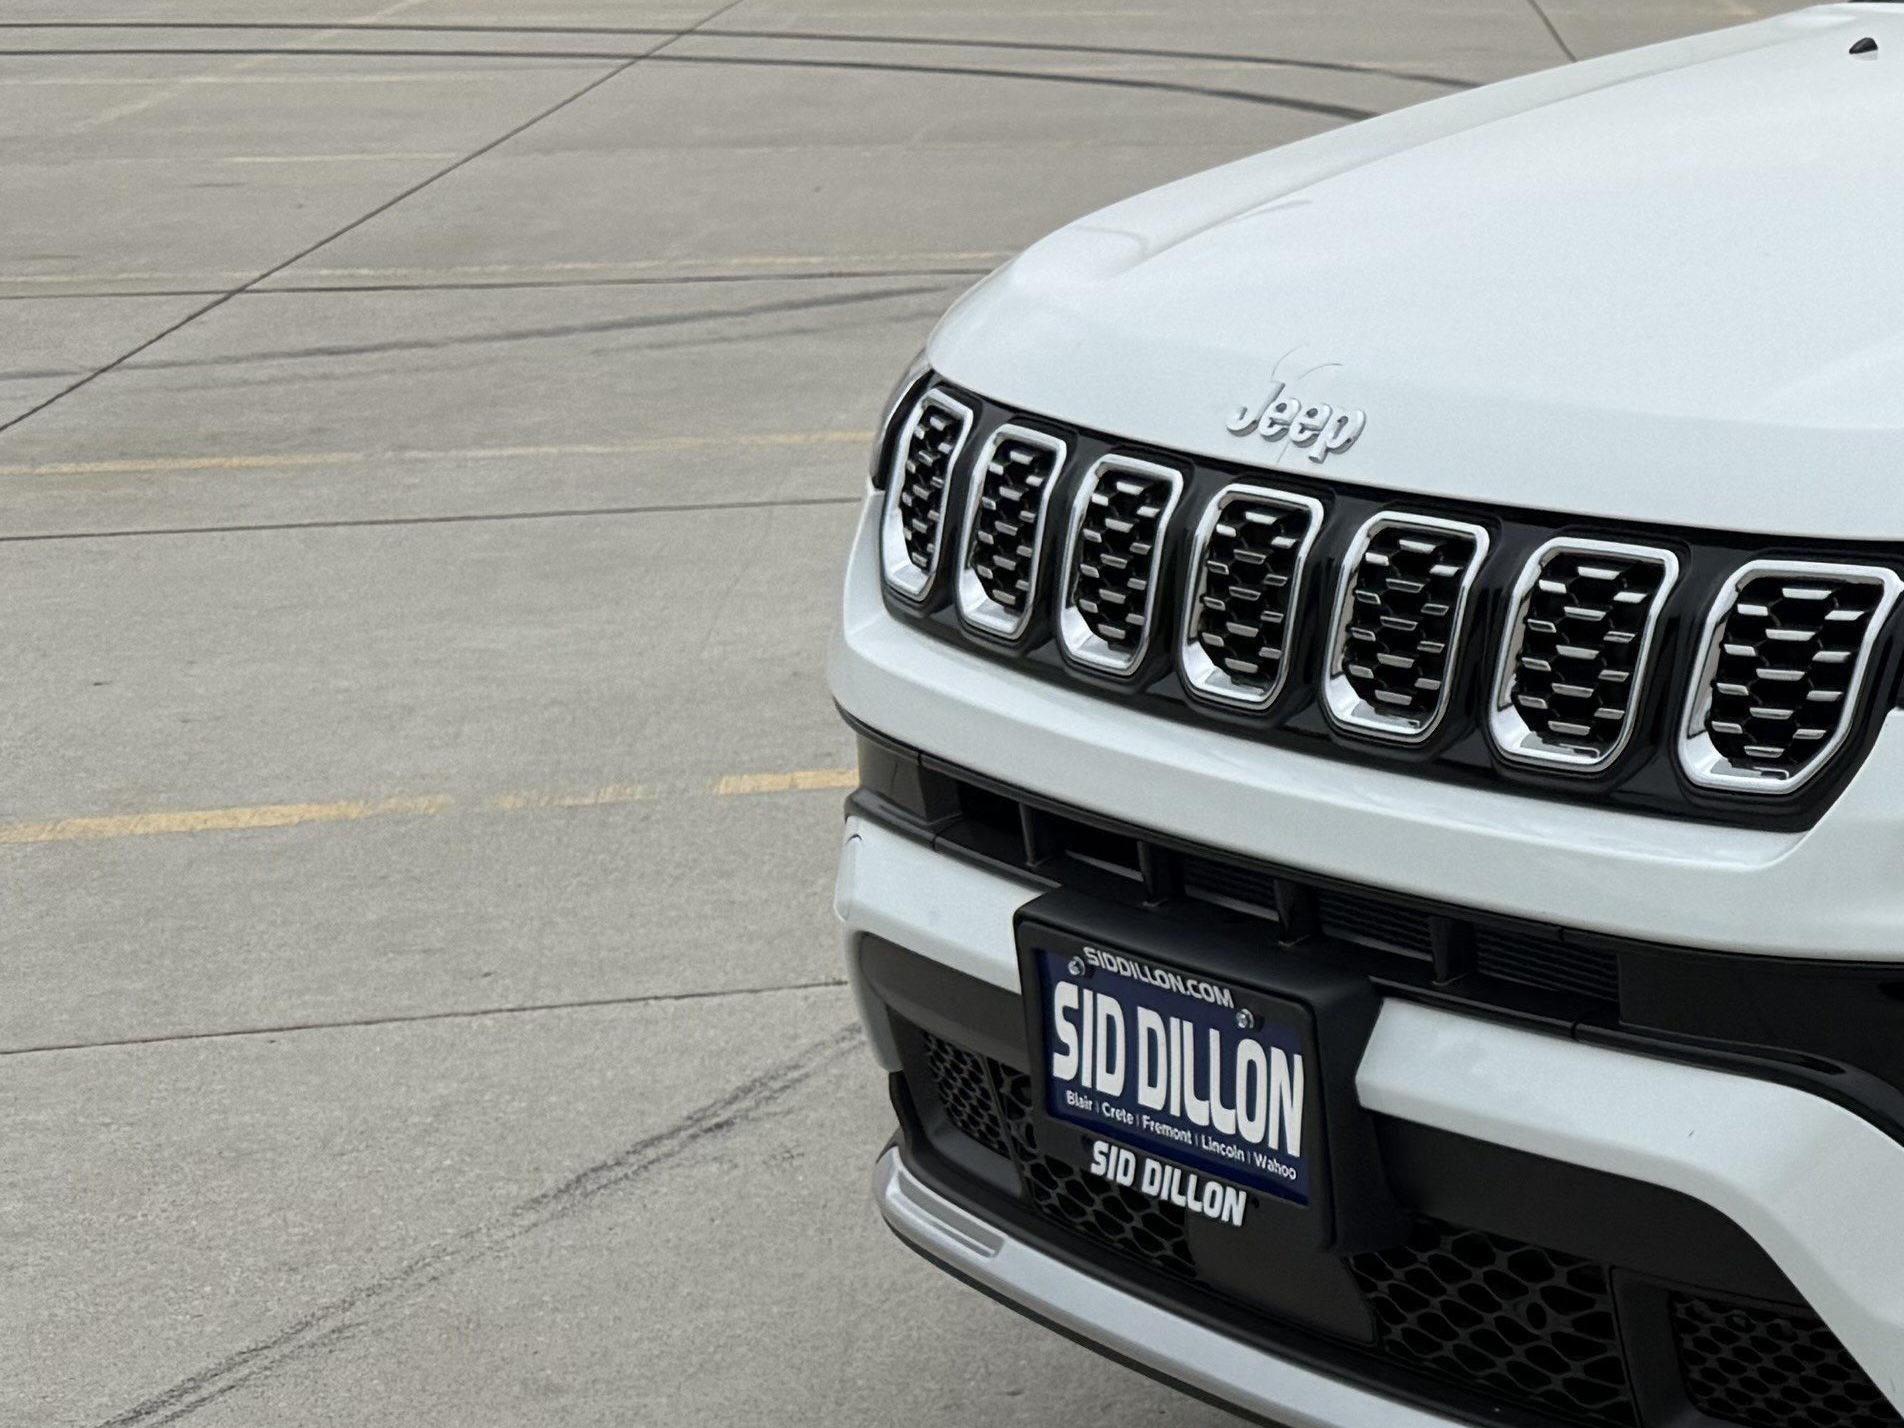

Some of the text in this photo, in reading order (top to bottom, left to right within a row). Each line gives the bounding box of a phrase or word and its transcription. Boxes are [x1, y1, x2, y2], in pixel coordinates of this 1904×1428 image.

[1226, 380, 1367, 463] Jeep
[1083, 946, 1235, 1009] SIDDILLON.COM
[1052, 980, 1305, 1158] SID DILLON
[1066, 1089, 1297, 1181] Blair Crete Fremont Lincoln Wahoo
[1090, 1139, 1247, 1227] SID DILLON
